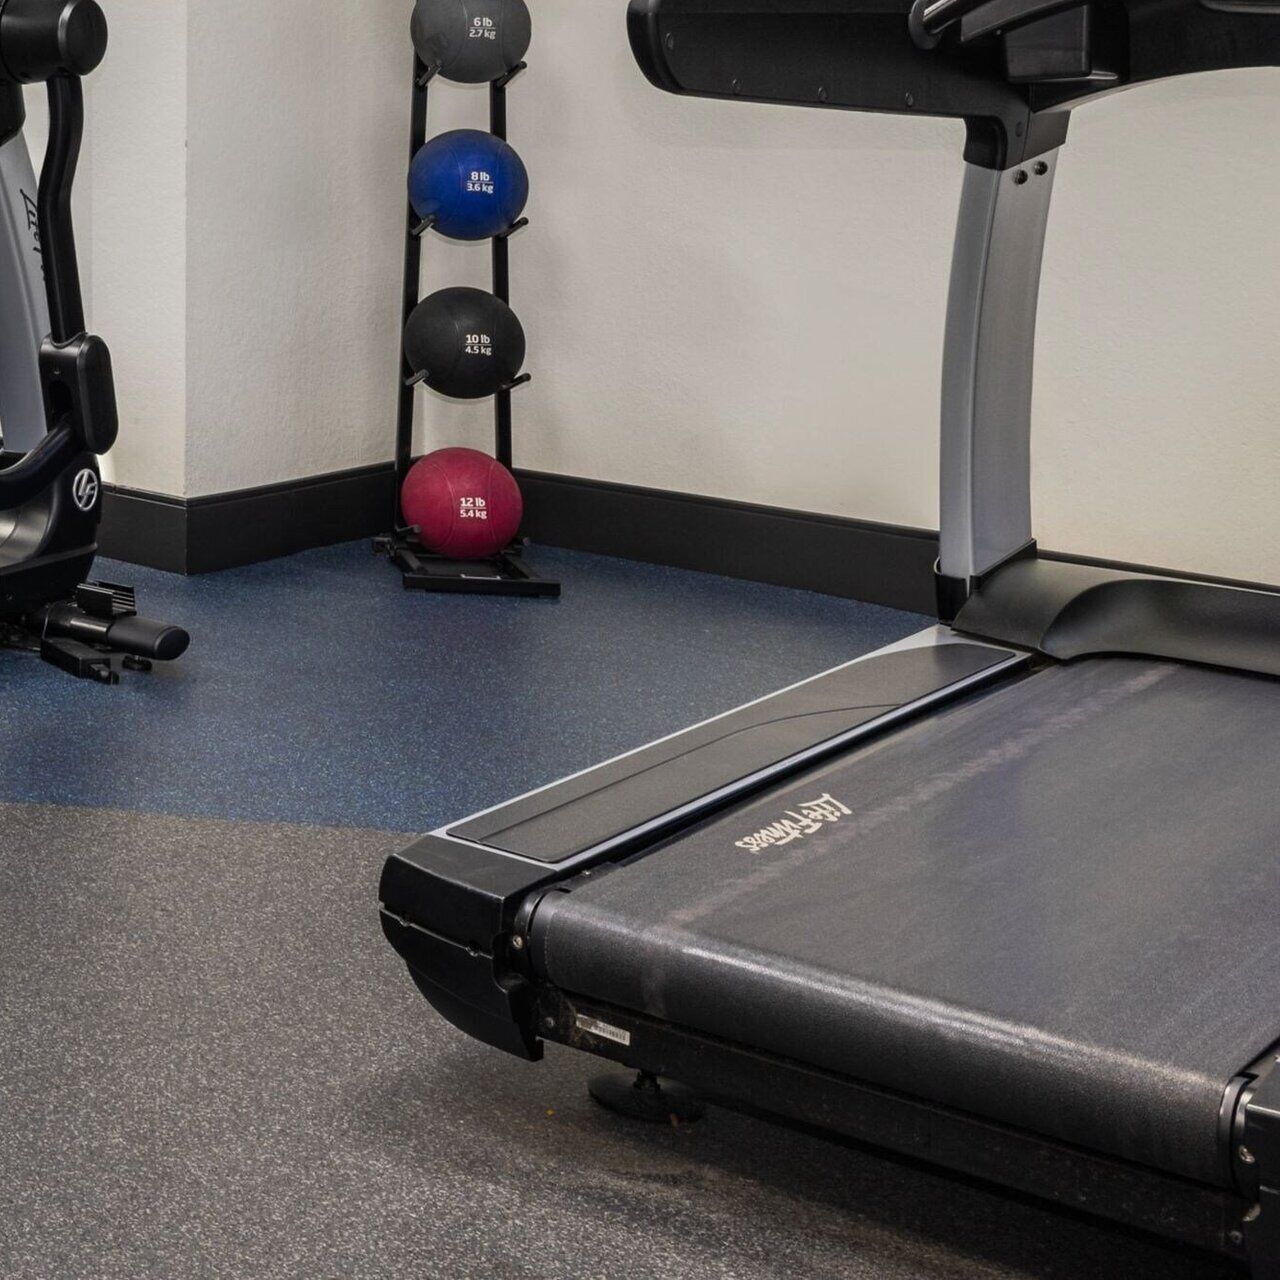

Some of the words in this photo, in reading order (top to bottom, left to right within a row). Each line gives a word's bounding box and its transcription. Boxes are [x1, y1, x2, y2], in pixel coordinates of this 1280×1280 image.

[473, 17, 482, 27] 6
[482, 17, 493, 27] lb
[469, 29, 483, 38] 2.7
[483, 29, 497, 40] kg
[470, 171, 479, 181] 8
[480, 171, 490, 181] lb
[466, 182, 481, 192] 3.6
[482, 183, 494, 194] kg
[465, 334, 480, 344] 10
[480, 334, 491, 344] lb
[465, 345, 480, 354] 4.5
[480, 346, 492, 356] kg
[460, 497, 474, 507] 12
[475, 497, 486, 507] lb
[460, 509, 474, 518] 5.4
[475, 509, 488, 520] kg
